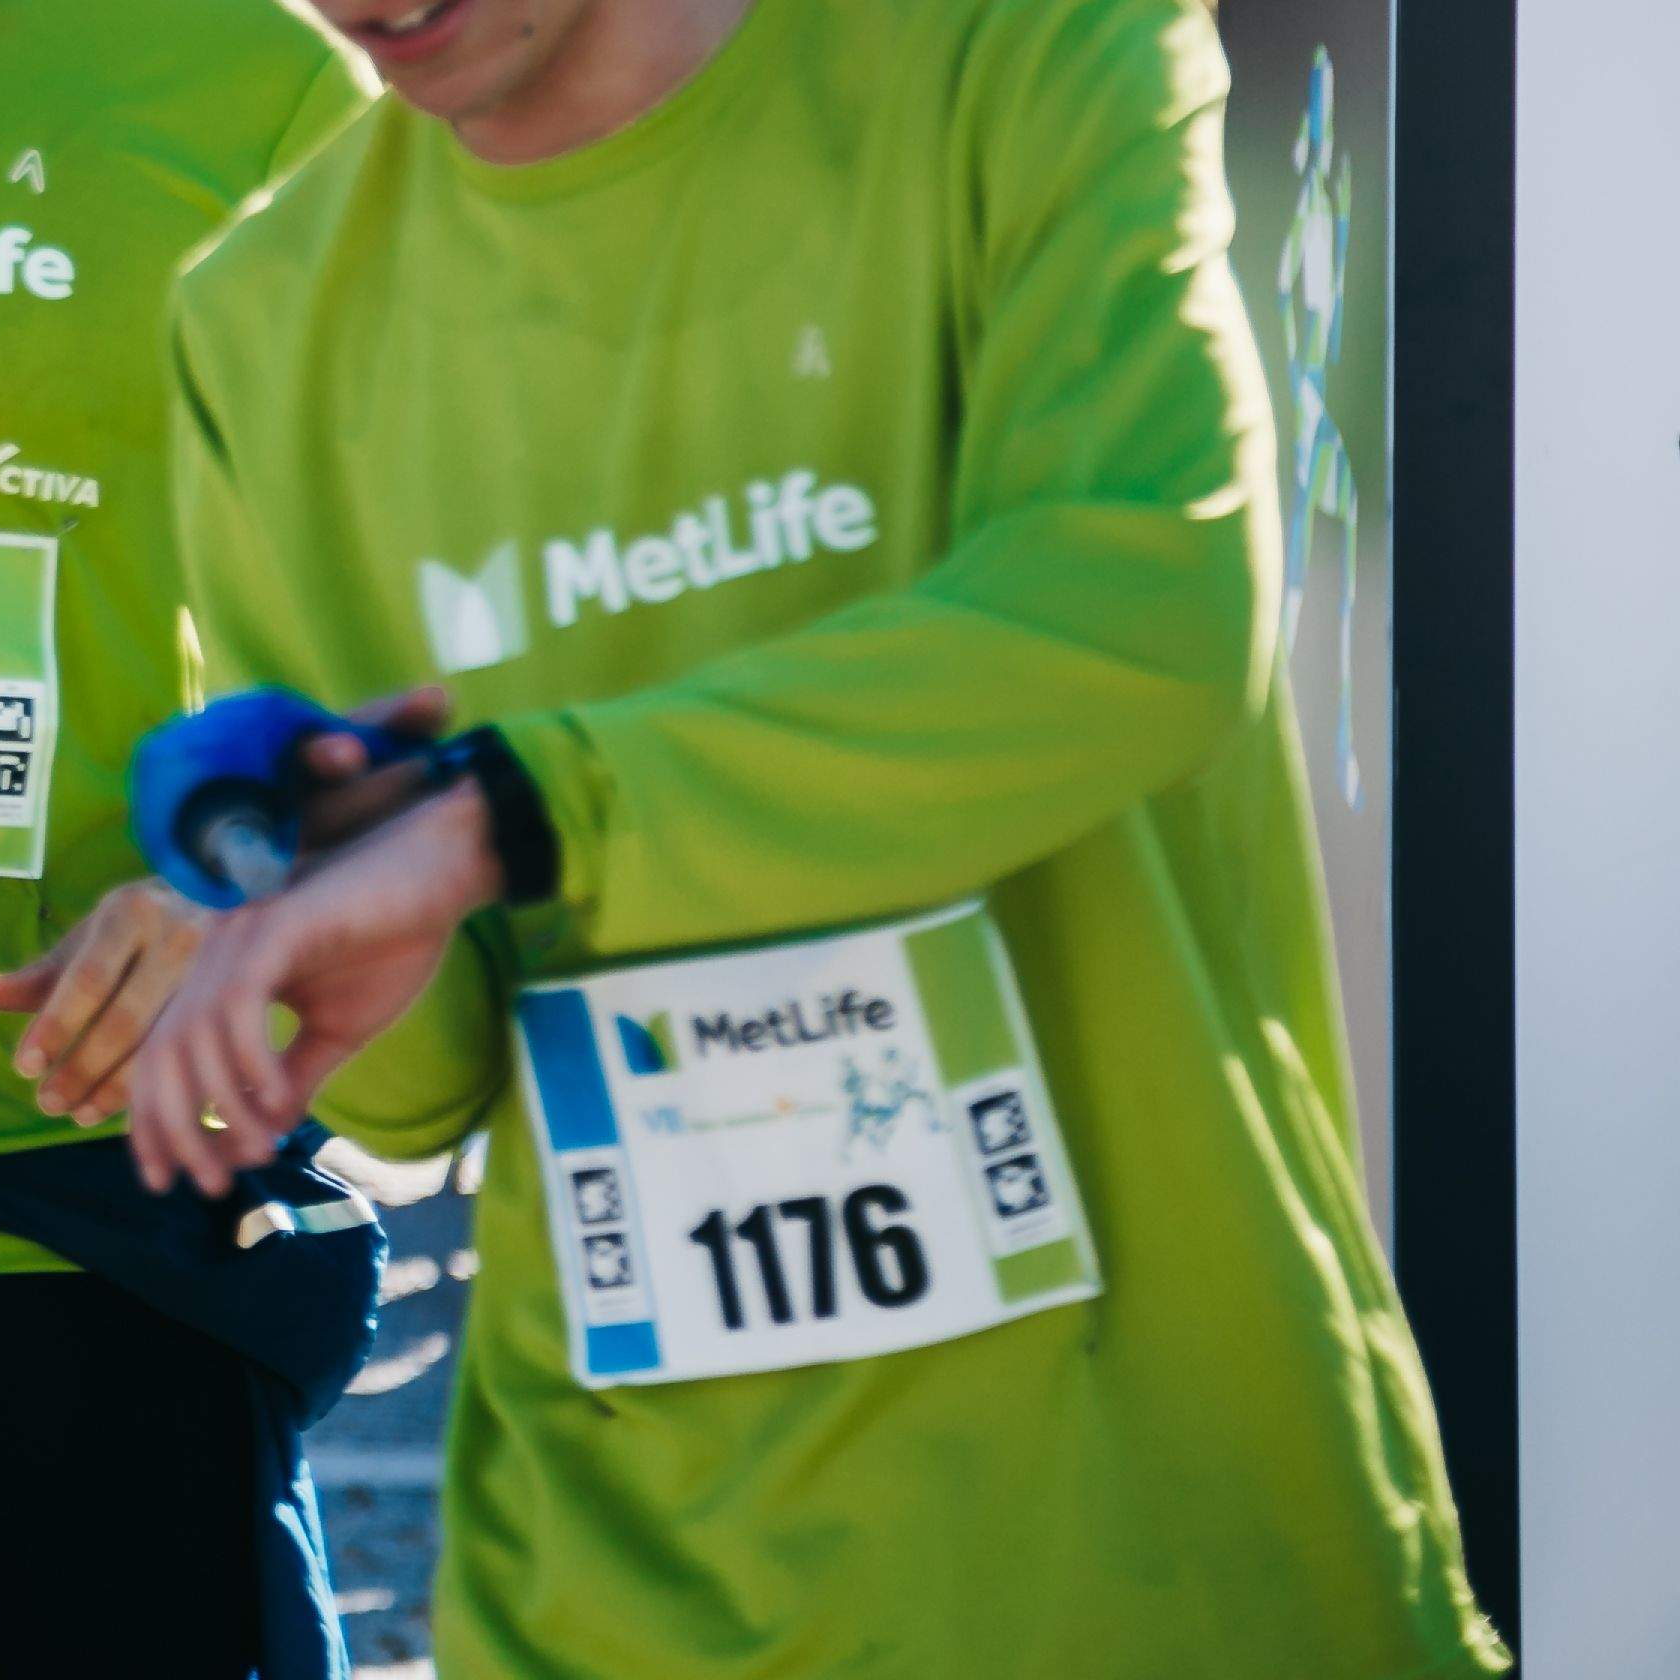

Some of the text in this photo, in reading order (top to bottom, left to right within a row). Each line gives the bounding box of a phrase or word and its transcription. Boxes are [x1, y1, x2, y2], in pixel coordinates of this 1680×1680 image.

[543, 468, 877, 628] MetLife
[690, 989, 896, 1057] MetLife
[689, 1182, 932, 1332] 1176
